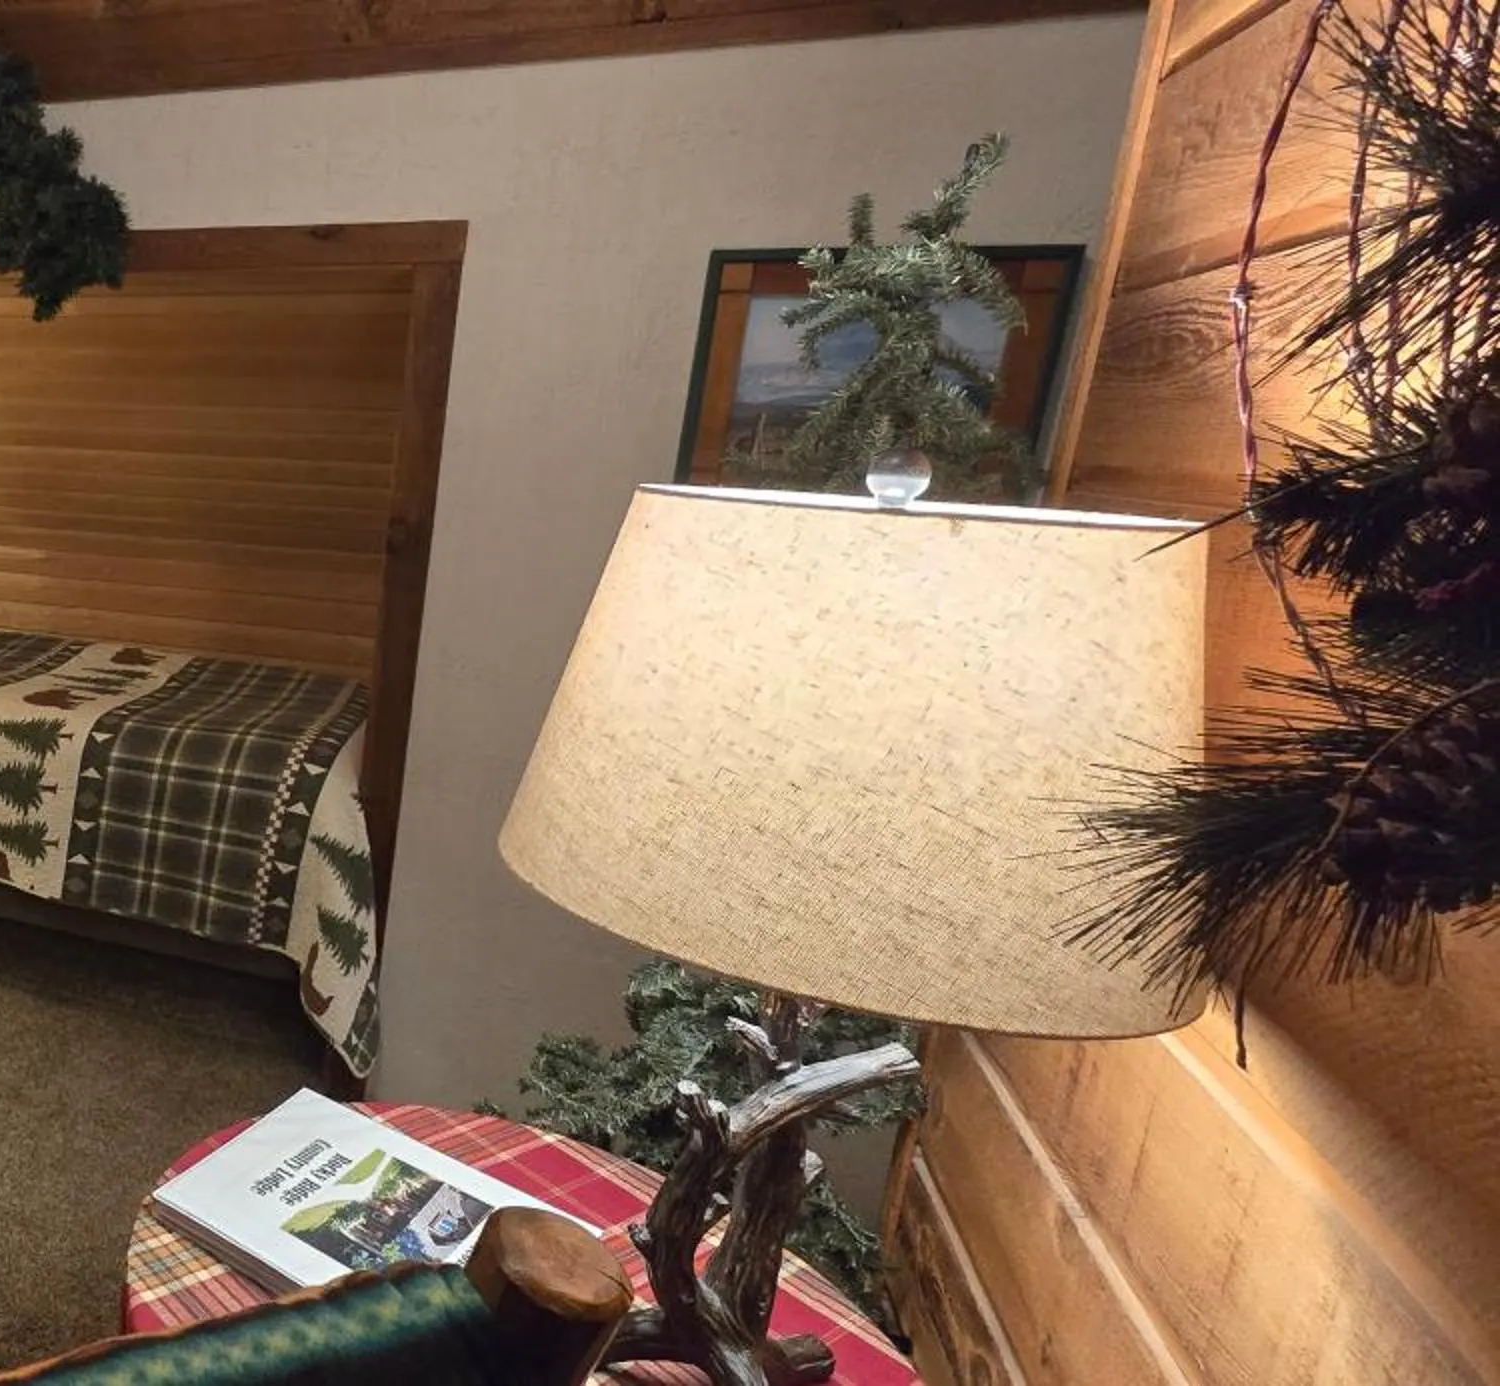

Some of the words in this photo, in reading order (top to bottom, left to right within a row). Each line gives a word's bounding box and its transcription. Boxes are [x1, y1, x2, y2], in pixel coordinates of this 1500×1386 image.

[283, 1138, 333, 1170] Country
[310, 1152, 353, 1181] Rocky
[250, 1166, 295, 1197] Lodge
[279, 1177, 322, 1206] Ridge
